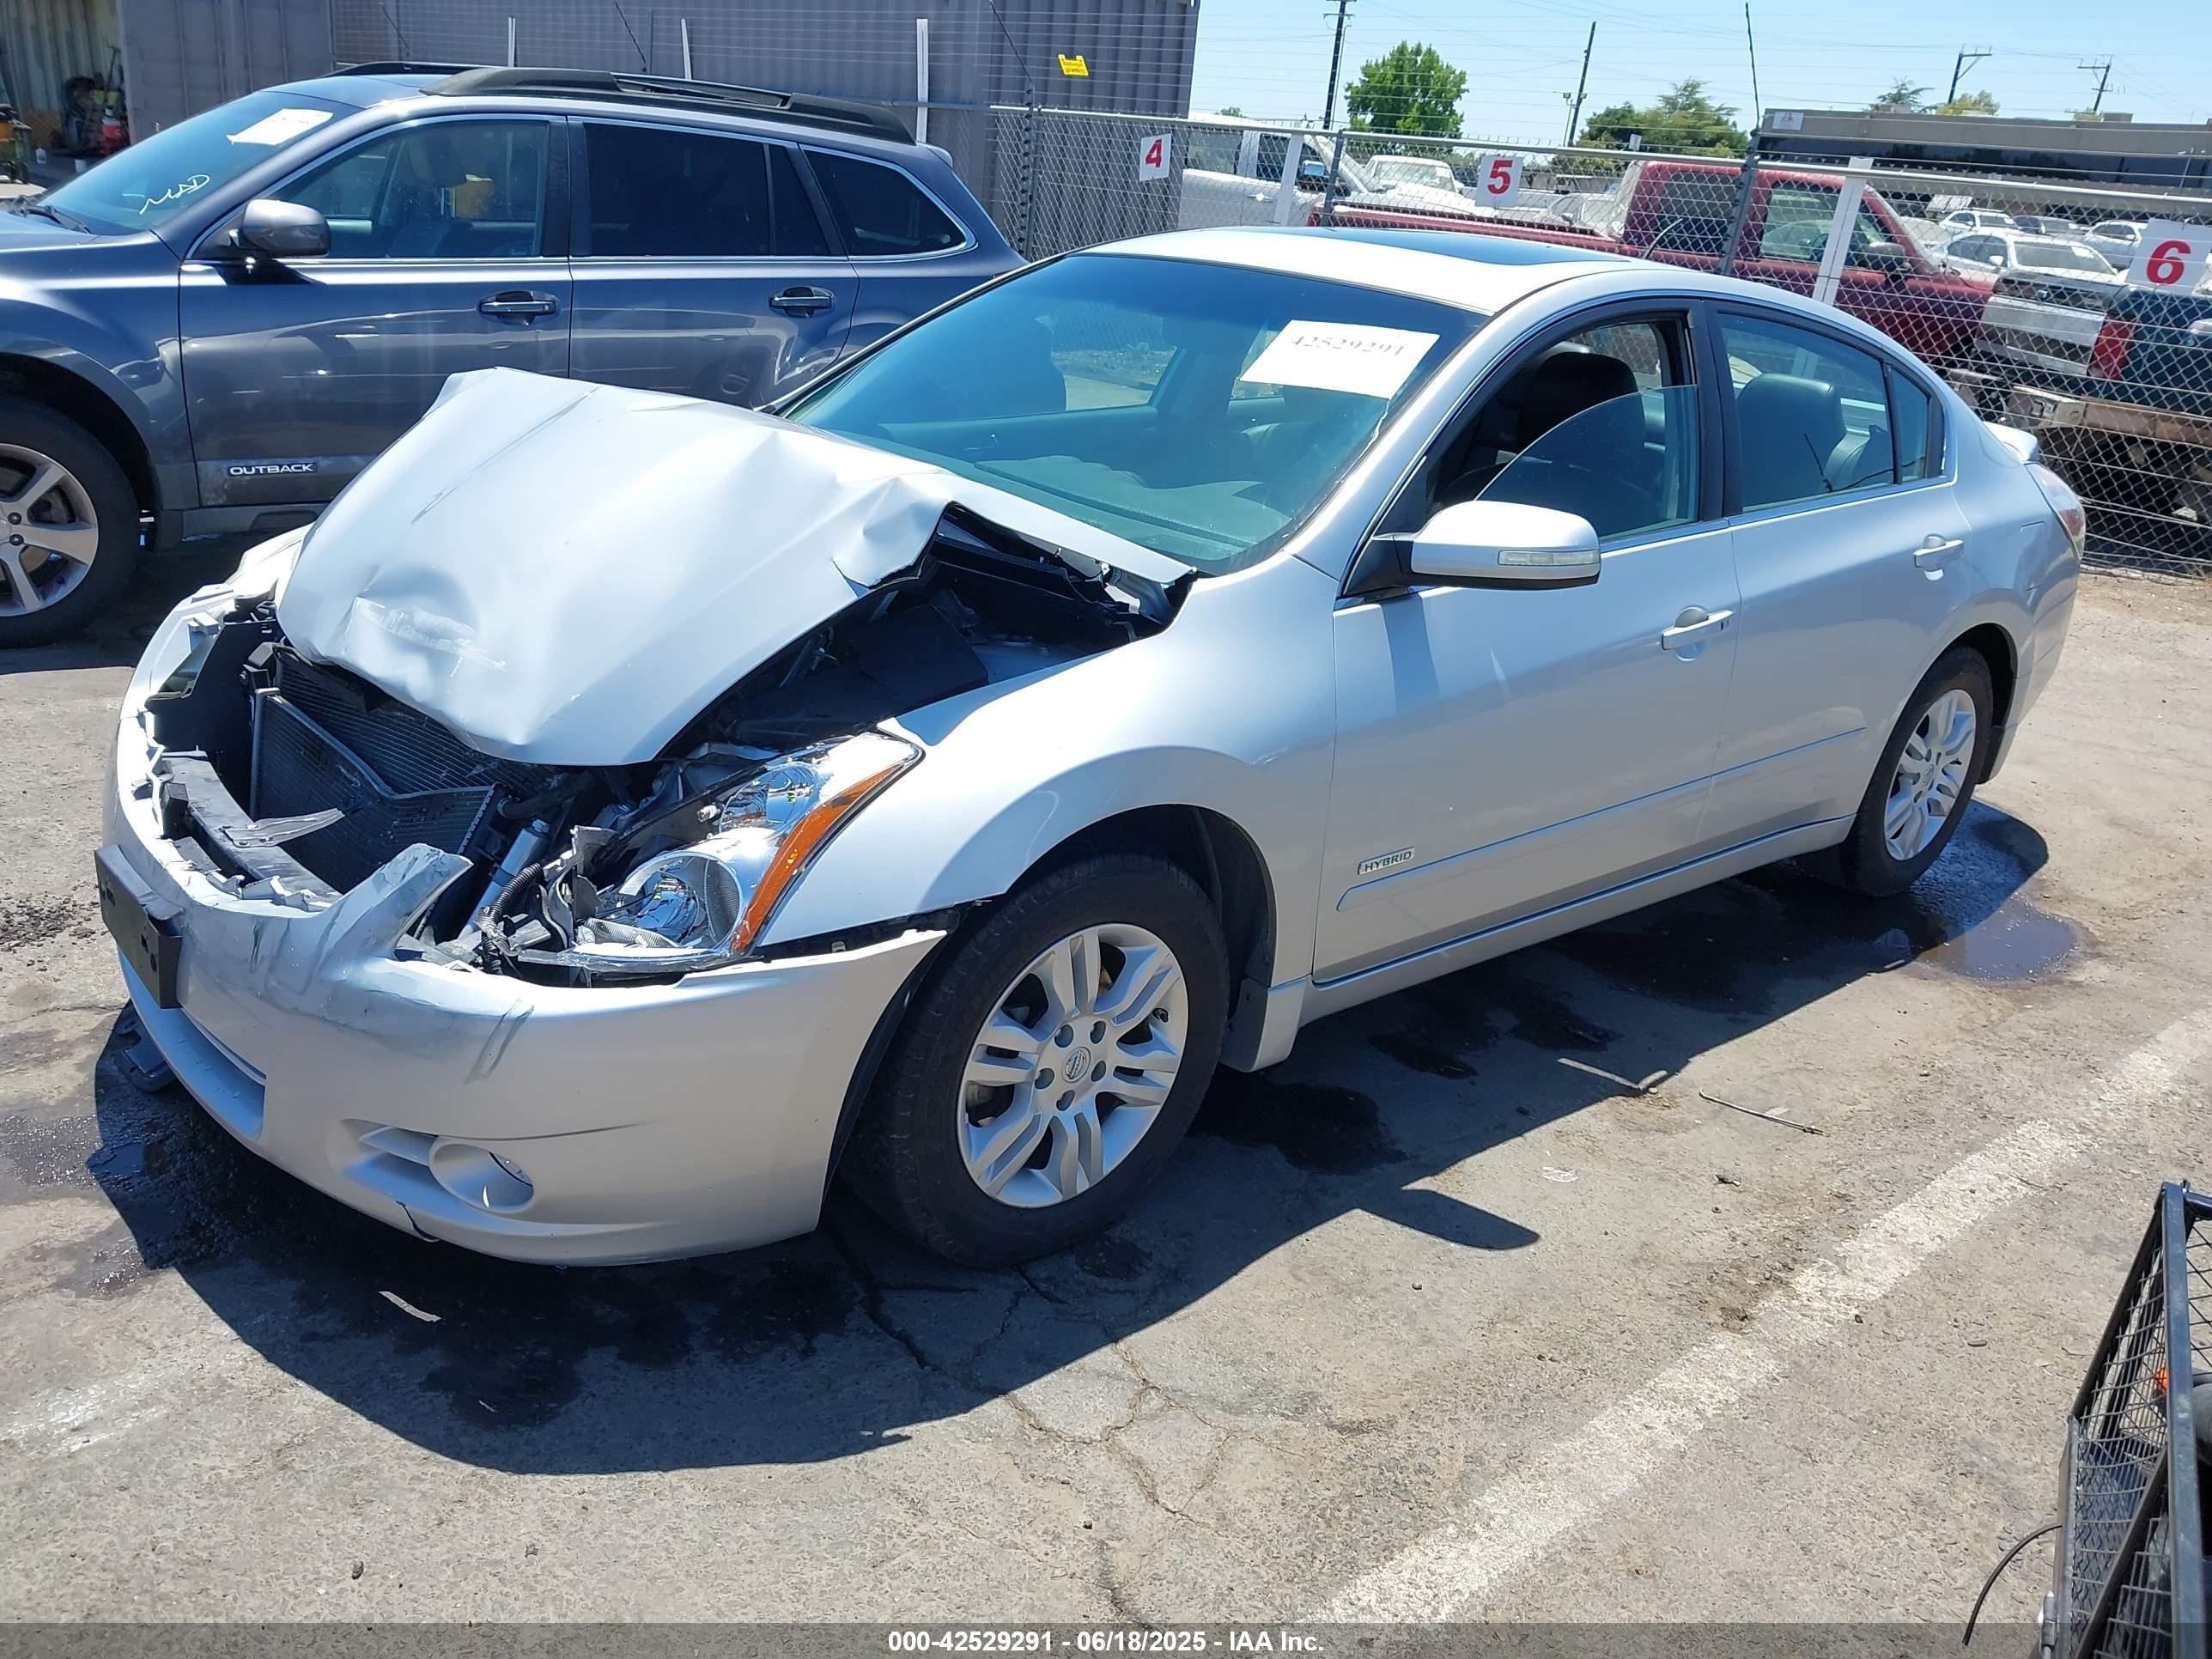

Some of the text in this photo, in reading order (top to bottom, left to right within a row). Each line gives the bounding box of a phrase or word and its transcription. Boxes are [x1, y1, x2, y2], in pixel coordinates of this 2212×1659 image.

[1146, 138, 1162, 167] 4
[1487, 160, 1513, 194] 5
[2147, 240, 2191, 284] 6
[229, 464, 314, 475] OUTBACK
[1364, 851, 1412, 872] HYBRID
